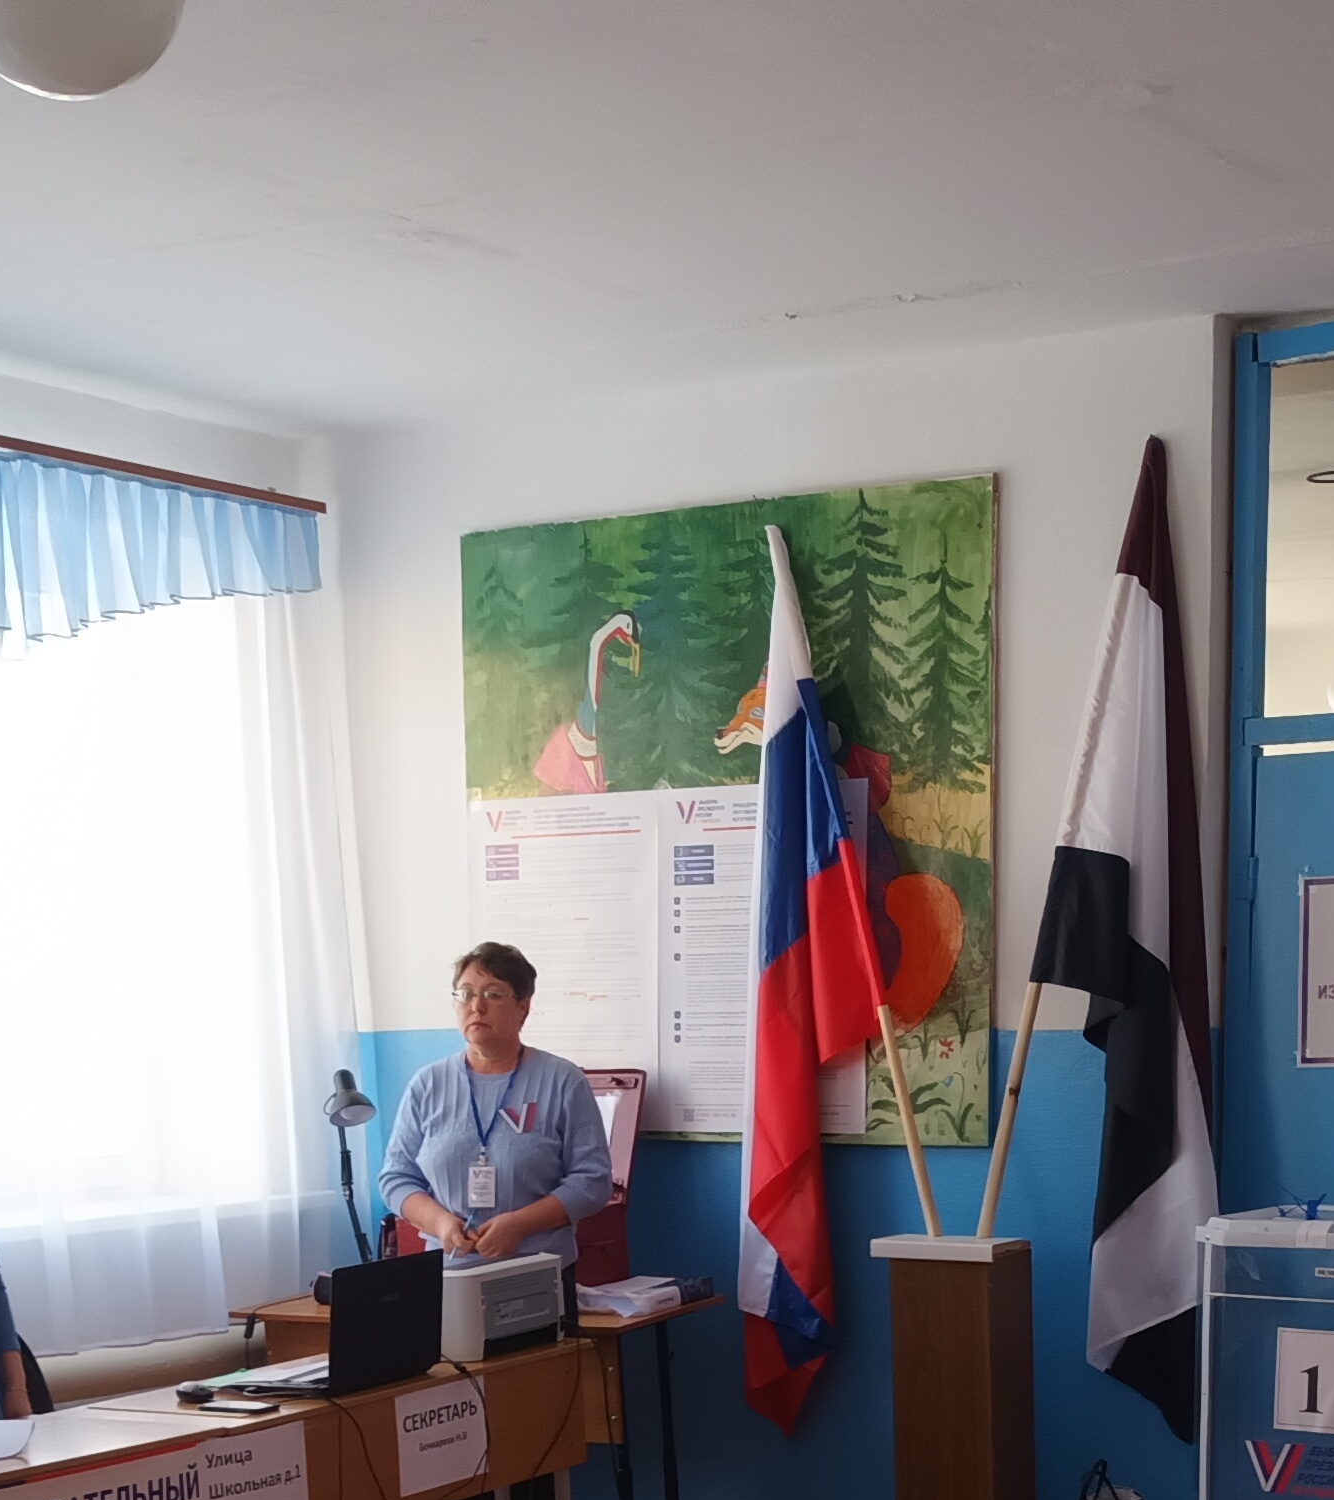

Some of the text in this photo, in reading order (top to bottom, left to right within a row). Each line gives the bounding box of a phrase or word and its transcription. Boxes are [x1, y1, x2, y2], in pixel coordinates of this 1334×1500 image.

[1298, 1364, 1323, 1414] 1
[402, 1400, 478, 1433] СЕКРЕТАРЬ
[205, 1449, 253, 1469] Улица
[208, 1472, 282, 1500] Школьная
